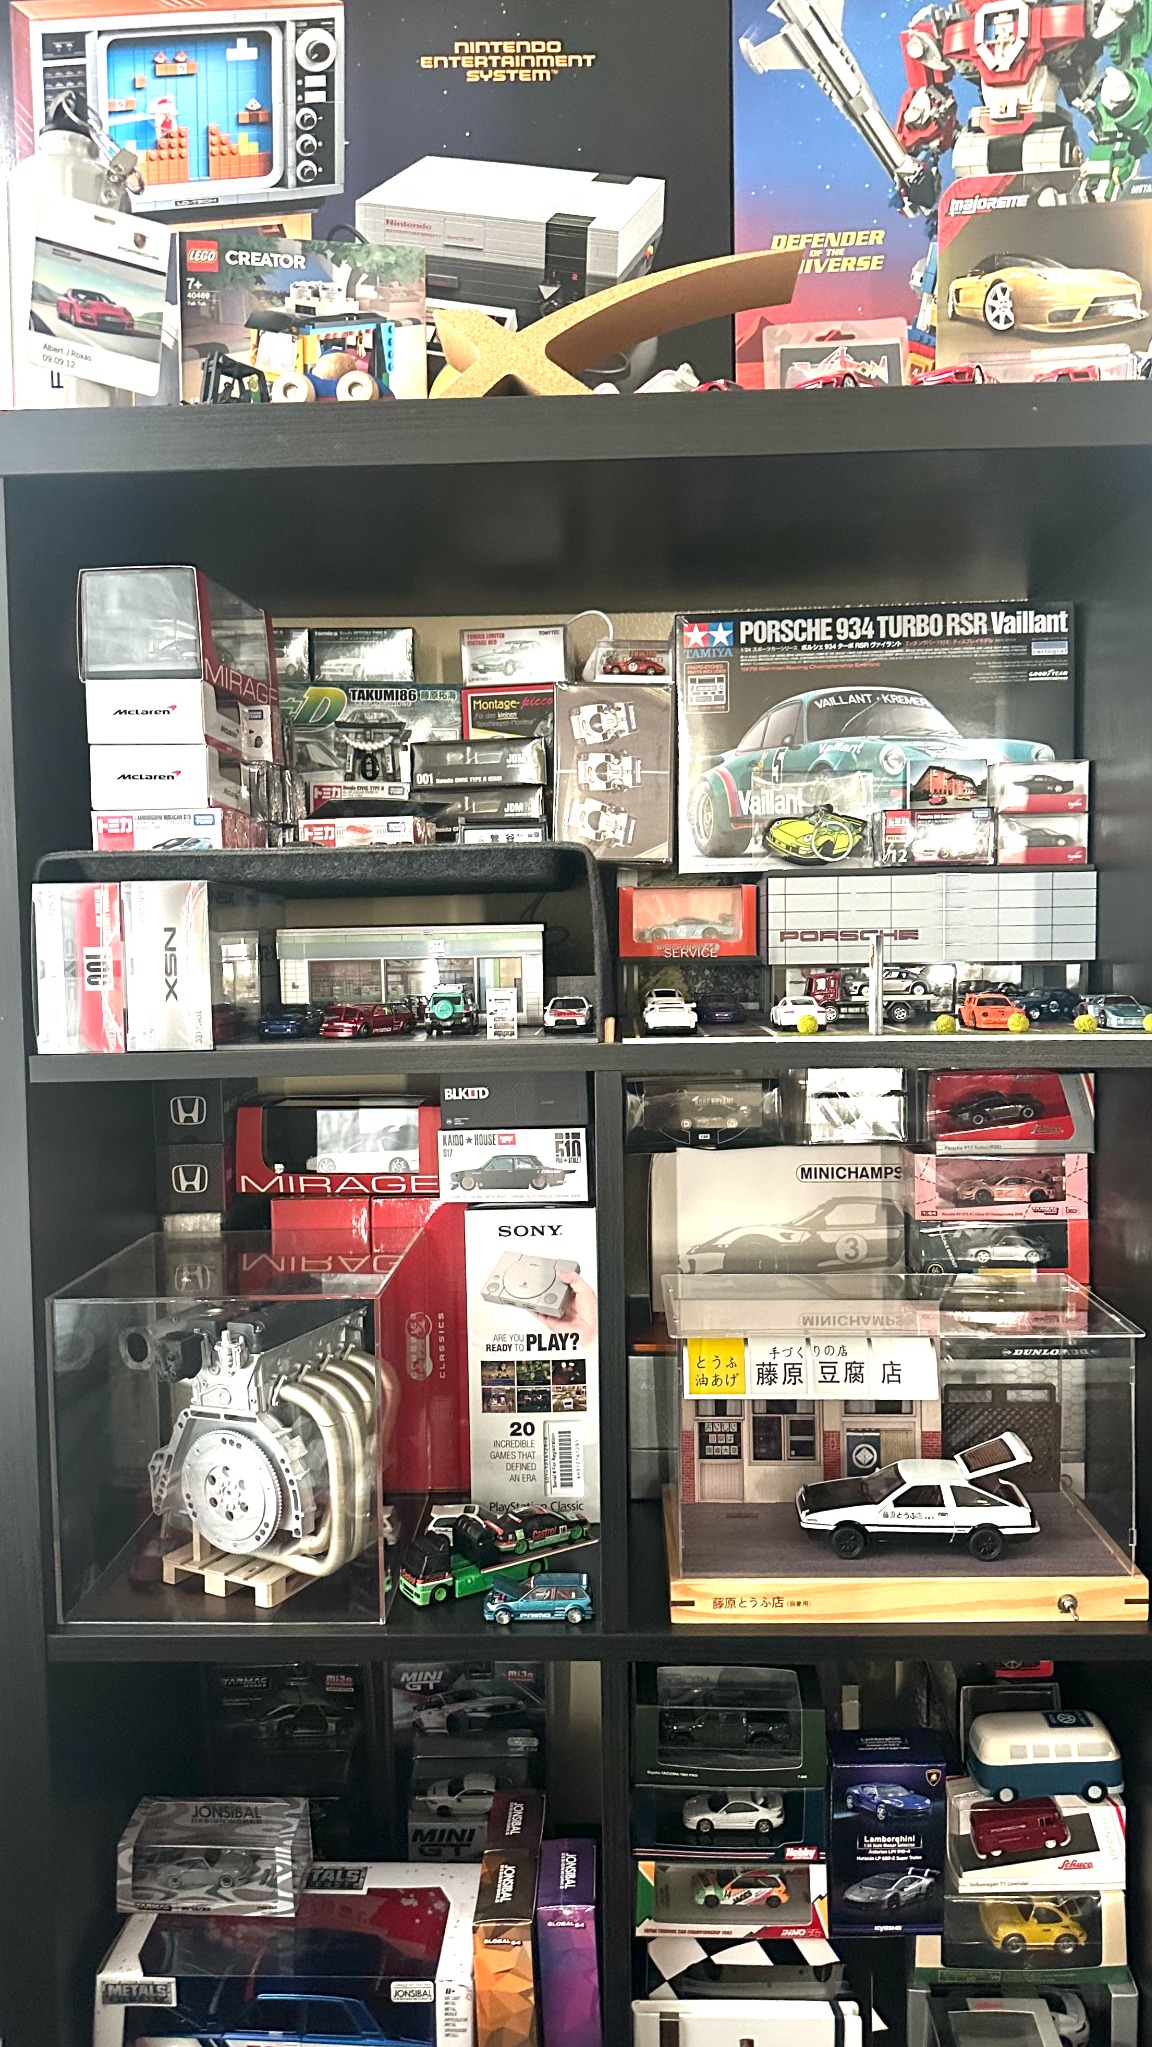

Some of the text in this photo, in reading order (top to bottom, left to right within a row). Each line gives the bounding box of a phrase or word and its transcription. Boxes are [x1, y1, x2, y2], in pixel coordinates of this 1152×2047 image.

[454, 40, 562, 55] NINTENDO
[420, 54, 597, 69] ENTERTAINMENT
[385, 218, 432, 230] Nintendo
[770, 229, 886, 251] DEFENDER
[188, 249, 216, 263] LEGO
[809, 247, 846, 258] OF THE
[224, 250, 307, 270] CREATOR
[186, 277, 203, 290] 7+
[42, 343, 64, 355] Albert
[71, 349, 92, 362] Roxas
[42, 353, 76, 369] 09.09.12
[740, 610, 1069, 644] PORSCHE 934 TURBO RSR Vaillant
[685, 648, 733, 659] TAMIYA
[204, 657, 278, 705] MIRAGE
[349, 688, 417, 703] TAKUMI86
[813, 693, 872, 709] VAILLANT
[473, 700, 520, 711] Montage-
[416, 773, 434, 785] 001
[314, 786, 341, 800] トミカ
[737, 787, 805, 817] Vaillant
[97, 817, 134, 834] トミカ
[304, 826, 335, 841] トミカ
[779, 929, 919, 943] PORSCHE
[664, 947, 718, 958] SERVICE
[163, 926, 179, 1002] NSX
[443, 1133, 497, 1147] KAIDO HOUSE
[800, 1166, 902, 1180] MINICHAMPS
[240, 1174, 440, 1194] MIRAGE
[498, 1224, 562, 1238] SONY
[843, 1237, 860, 1261] 3
[485, 1332, 580, 1352] READY TO PLAY?
[493, 1333, 525, 1342] ARE YOU
[437, 1312, 446, 1379] CLASSICS
[768, 1344, 849, 1360] 手づくりの店
[695, 1355, 738, 1369] とうふ
[695, 1372, 740, 1388] 油あげ
[509, 1421, 535, 1437] 20
[493, 1439, 536, 1448] INCREDIBLE
[489, 1451, 536, 1460] GAMES THAT
[505, 1462, 537, 1471] DEFINED
[509, 1473, 537, 1482] AN ERA
[550, 1500, 585, 1511] Classic
[532, 1525, 557, 1540] Castrol
[712, 1596, 785, 1610] 藤原とうふ店
[400, 1670, 444, 1683] MINI
[405, 1680, 441, 1691] GT
[510, 1801, 524, 1836] JONSIBAL
[411, 1828, 477, 1844] MINI
[863, 1834, 916, 1844] Lamborghini
[564, 1852, 577, 1890] JONSIBAL
[1057, 1859, 1094, 1871] Schuco
[499, 1864, 516, 1903] JONSIBAL
[723, 1889, 732, 1899] 14
[107, 1983, 167, 1997] METALS
[392, 1988, 433, 1999] JONSIBAL
